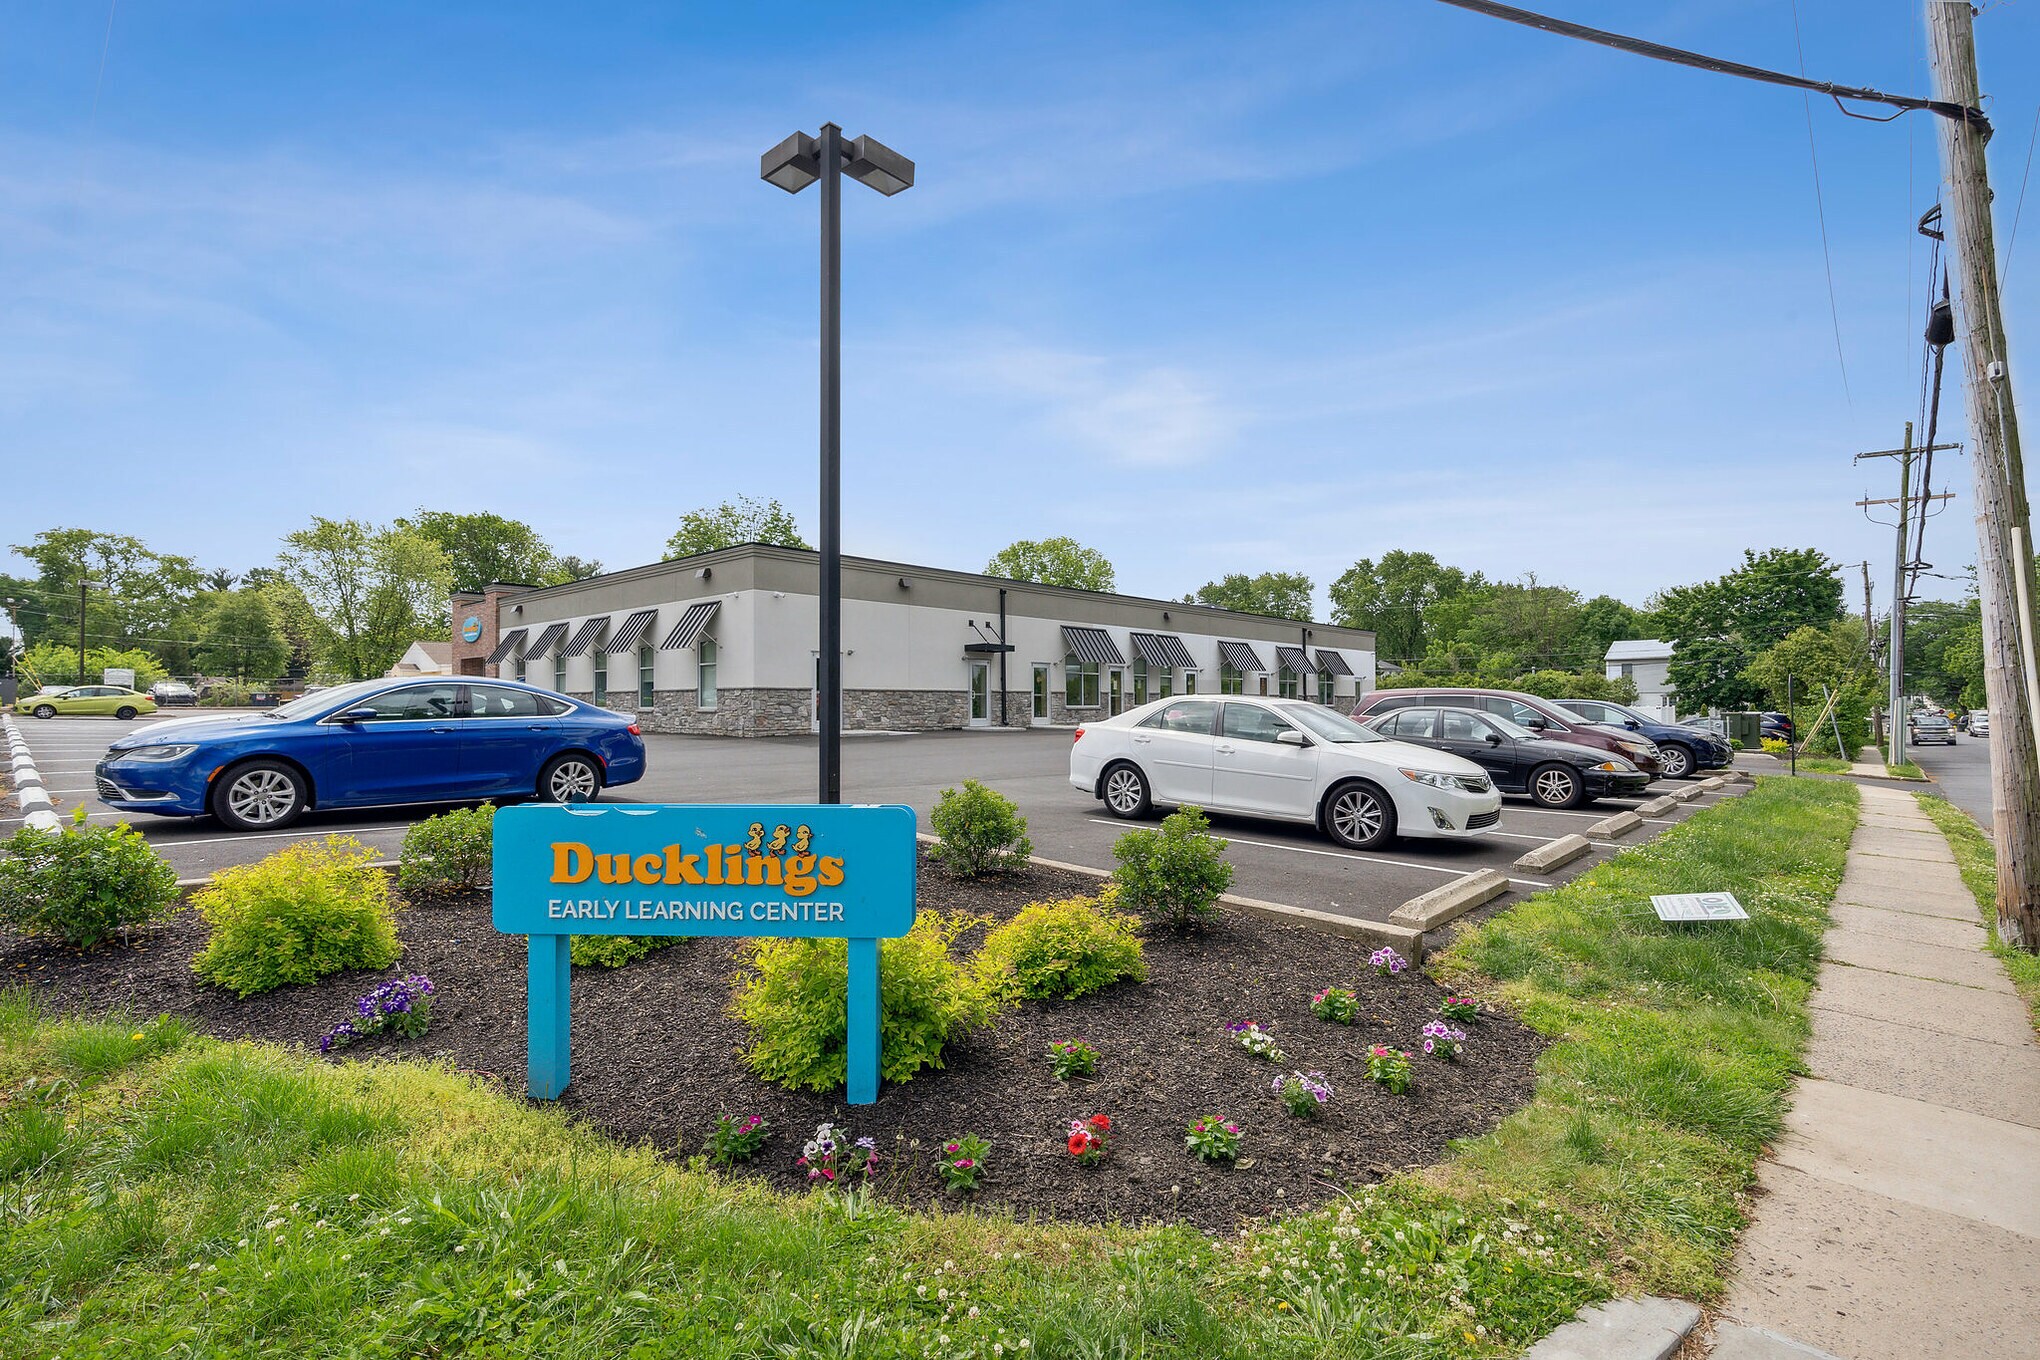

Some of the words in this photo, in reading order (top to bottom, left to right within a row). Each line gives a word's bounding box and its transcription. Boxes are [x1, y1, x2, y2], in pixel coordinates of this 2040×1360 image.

[550, 842, 845, 896] Ducklings
[548, 900, 621, 919] EARLY
[625, 900, 743, 921] LEARNING
[750, 902, 844, 922] CENTER
